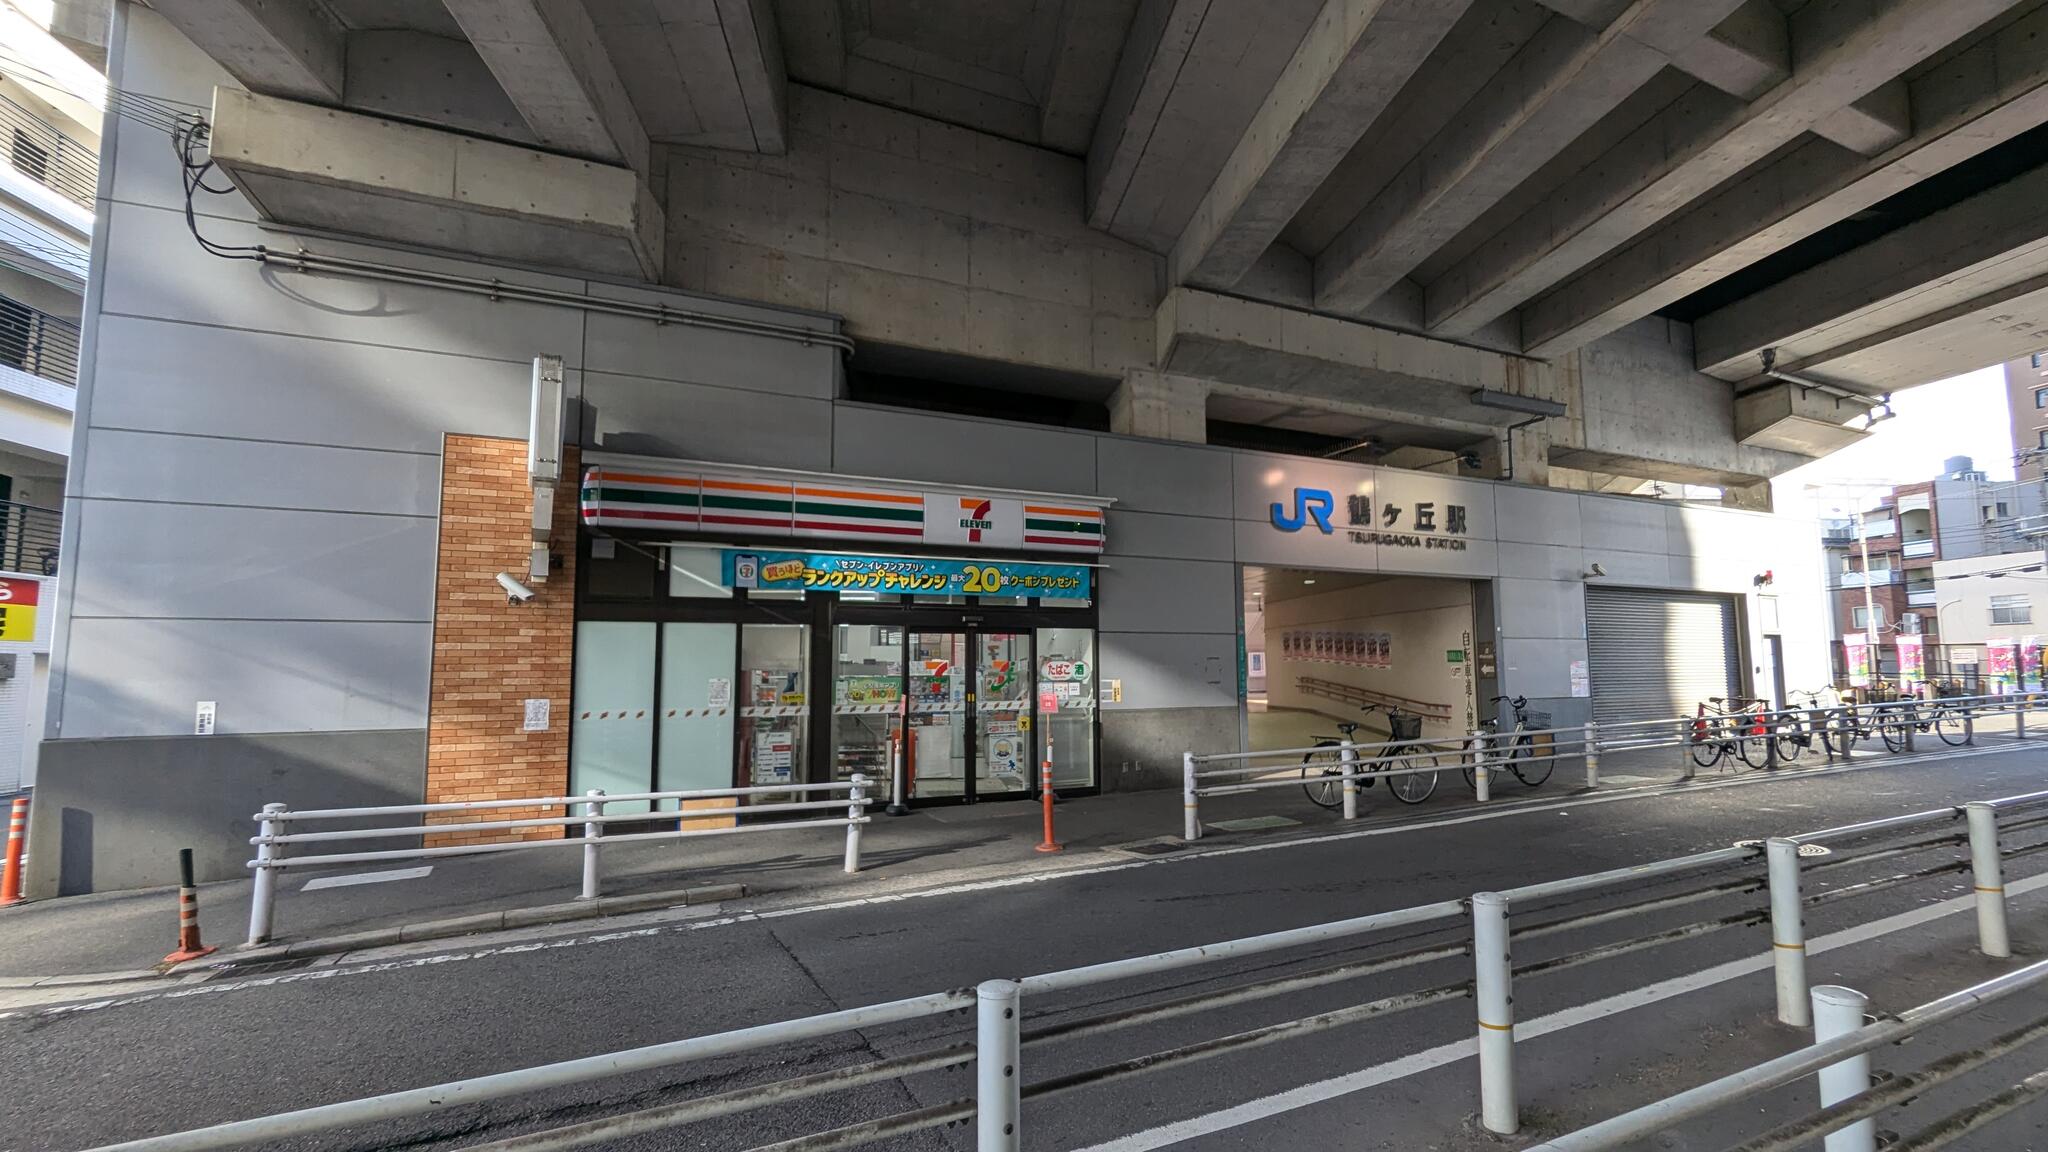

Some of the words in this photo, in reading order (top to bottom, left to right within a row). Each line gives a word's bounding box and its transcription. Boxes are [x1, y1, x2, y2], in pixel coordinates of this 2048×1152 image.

[1271, 488, 1333, 534] JR
[1348, 531, 1421, 549] TSURUGAOKA
[1425, 537, 1467, 551] STATION
[802, 568, 947, 590] ランクアップチャレンジ
[1047, 664, 1071, 675] たばこ
[1075, 664, 1085, 675] 酒
